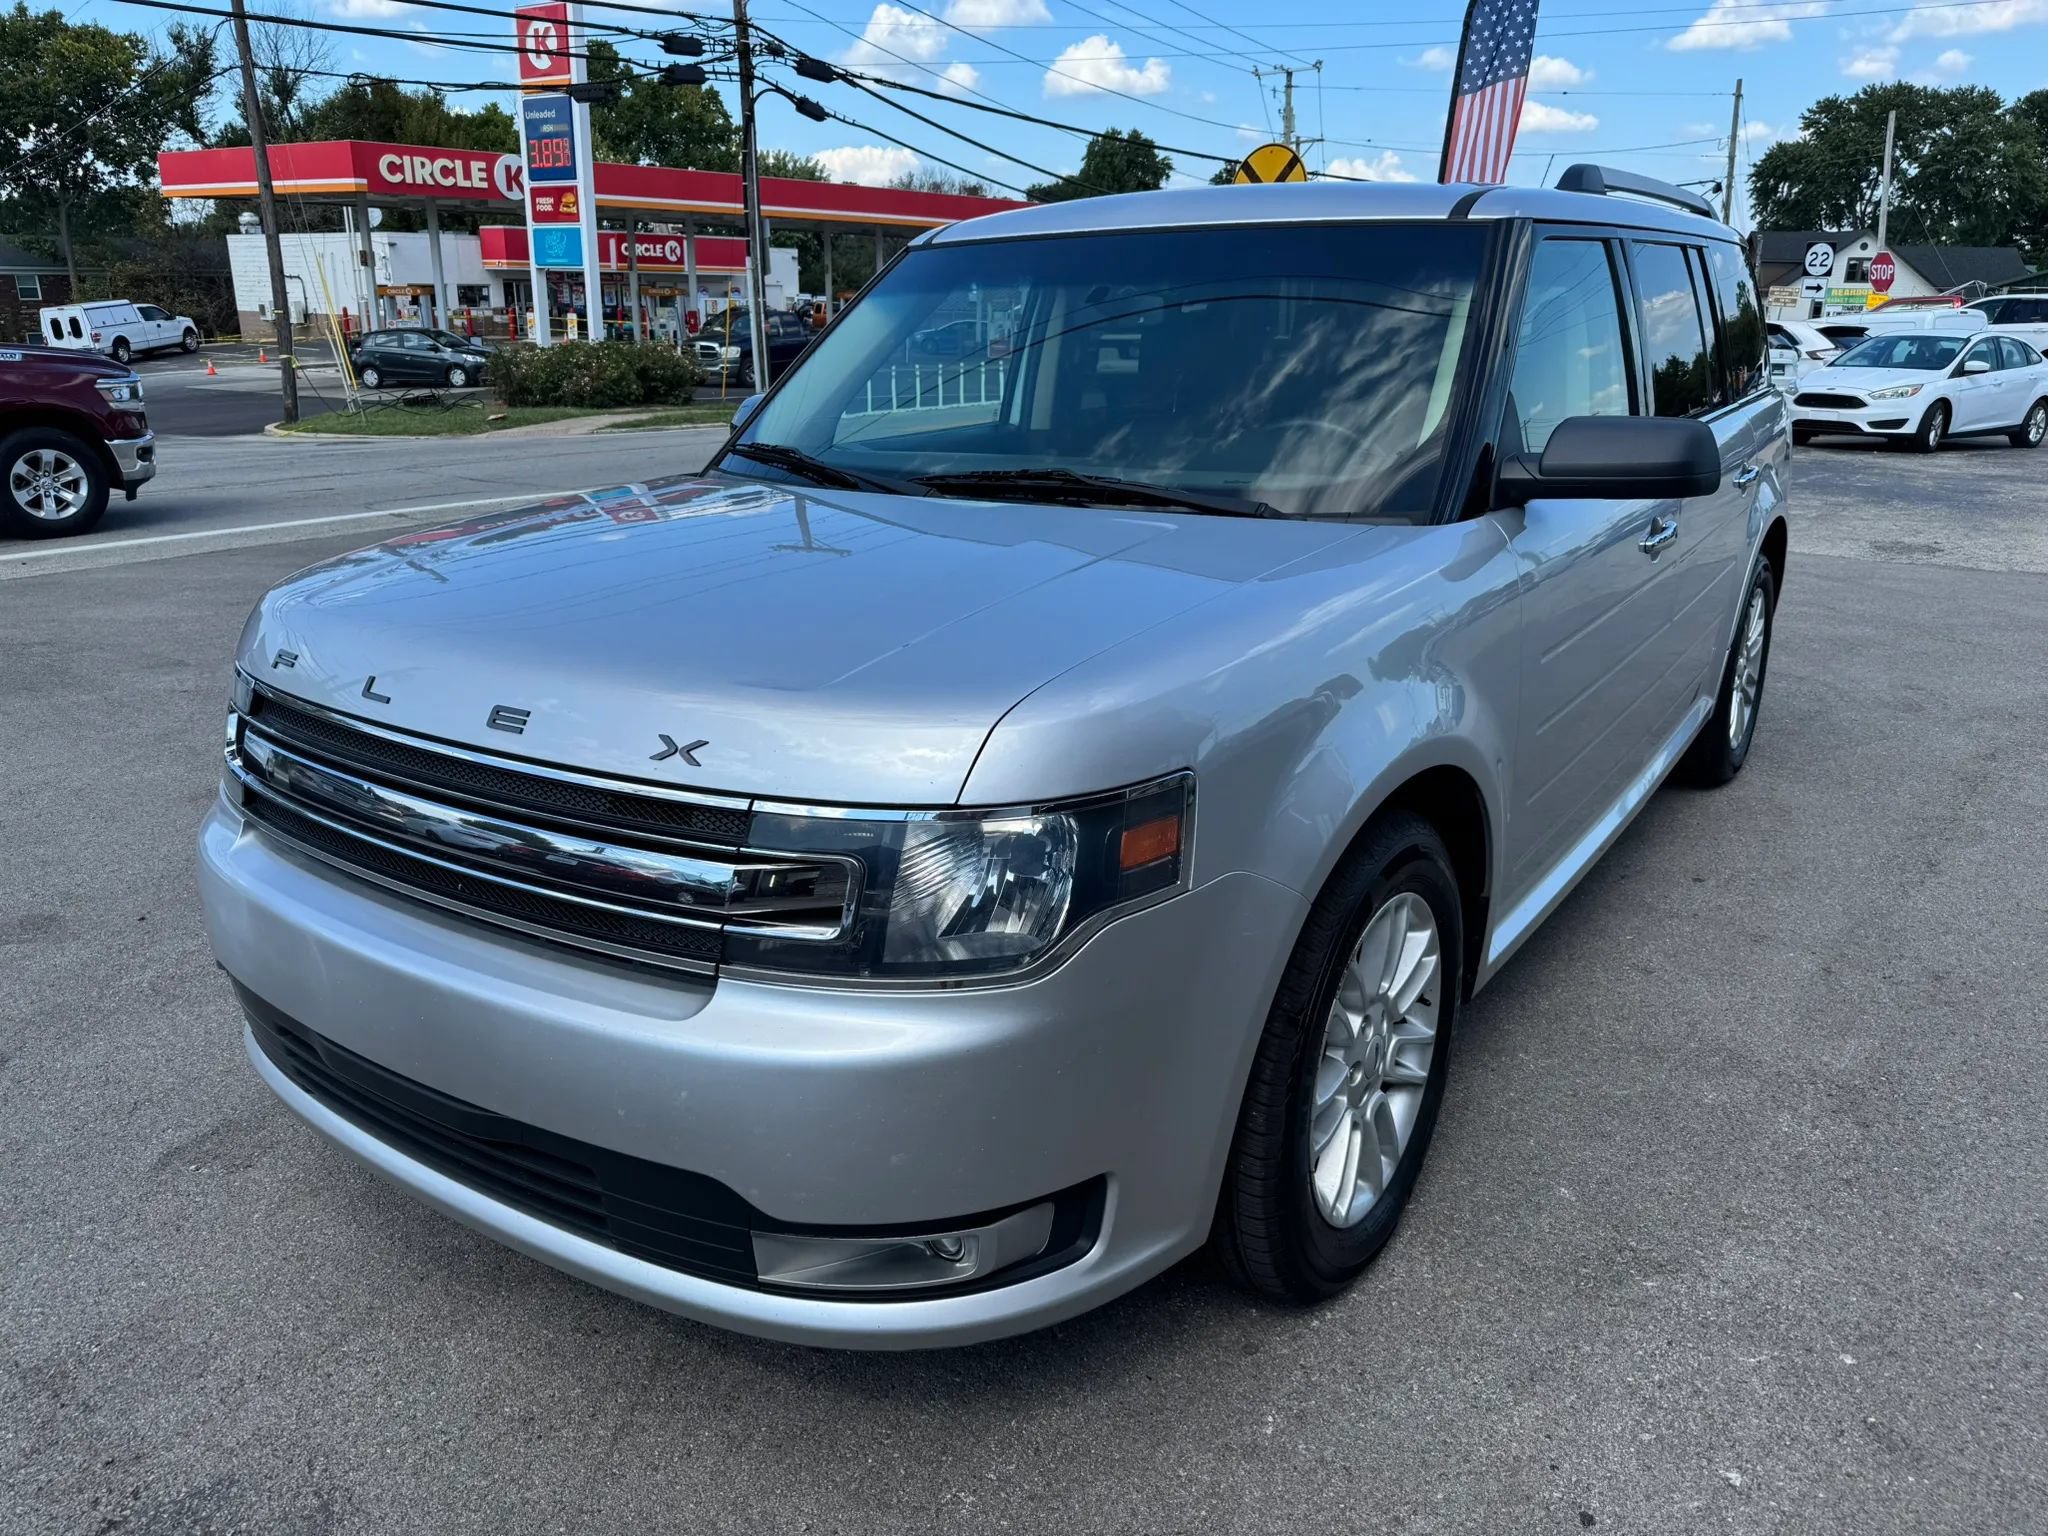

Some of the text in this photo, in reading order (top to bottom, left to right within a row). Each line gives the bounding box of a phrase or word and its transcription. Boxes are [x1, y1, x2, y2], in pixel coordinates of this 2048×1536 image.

[525, 109, 556, 119] Unleaded
[379, 154, 488, 189] CIRCLE
[621, 243, 663, 257] CRCLE
[1808, 252, 1830, 267] 22
[1870, 264, 1894, 280] STOP
[271, 648, 709, 768] FLEX
